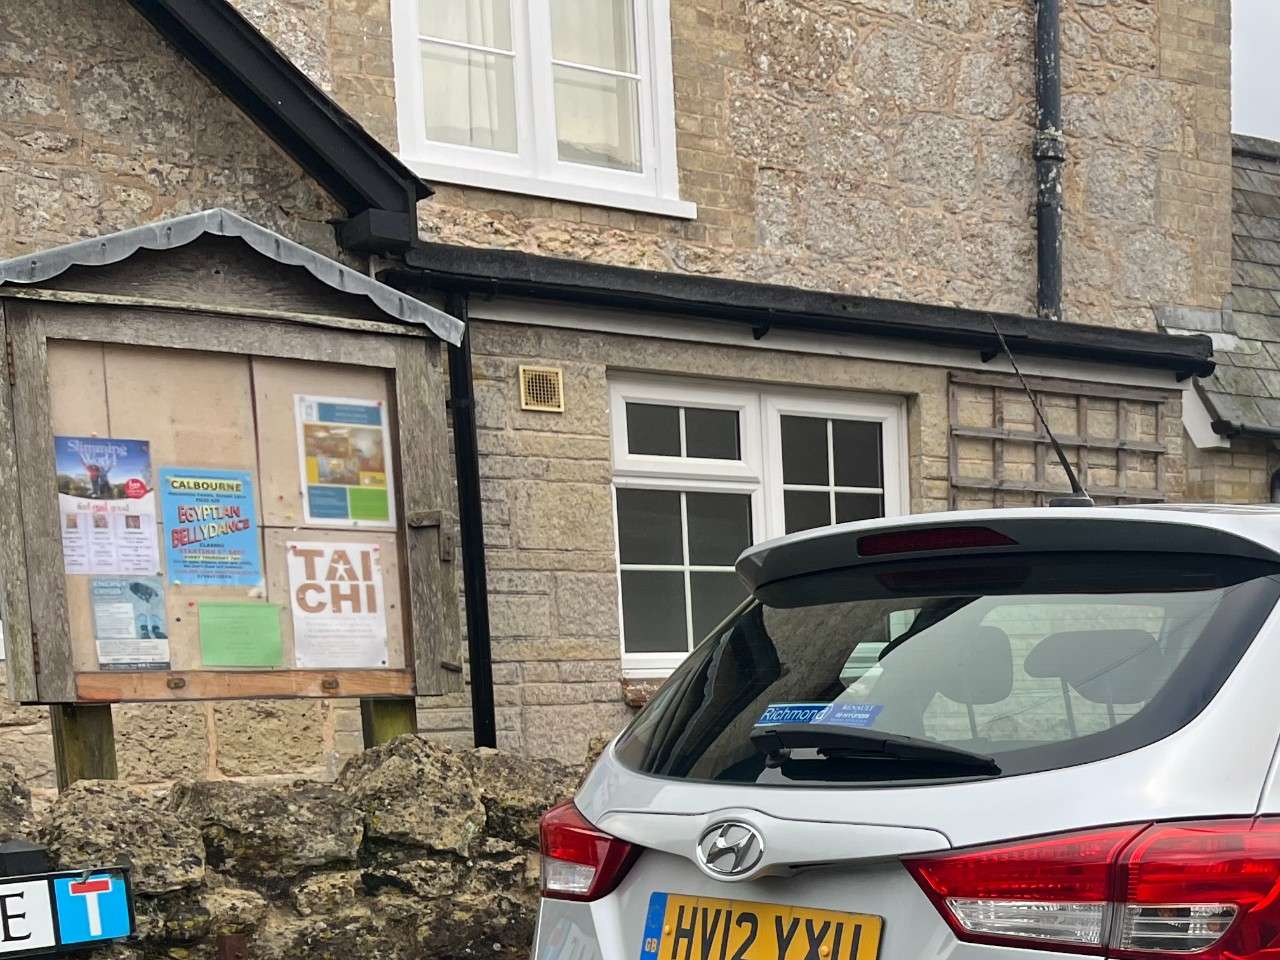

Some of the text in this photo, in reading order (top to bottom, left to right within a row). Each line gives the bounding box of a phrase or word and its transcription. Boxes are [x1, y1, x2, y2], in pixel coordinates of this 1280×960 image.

[170, 480, 242, 492] CALBOURNE
[177, 504, 241, 524] EGYPTIAN
[171, 518, 251, 549] BELLYDANCE
[292, 549, 373, 582] TAI
[295, 582, 378, 614] CHI
[759, 707, 829, 721] Richmond
